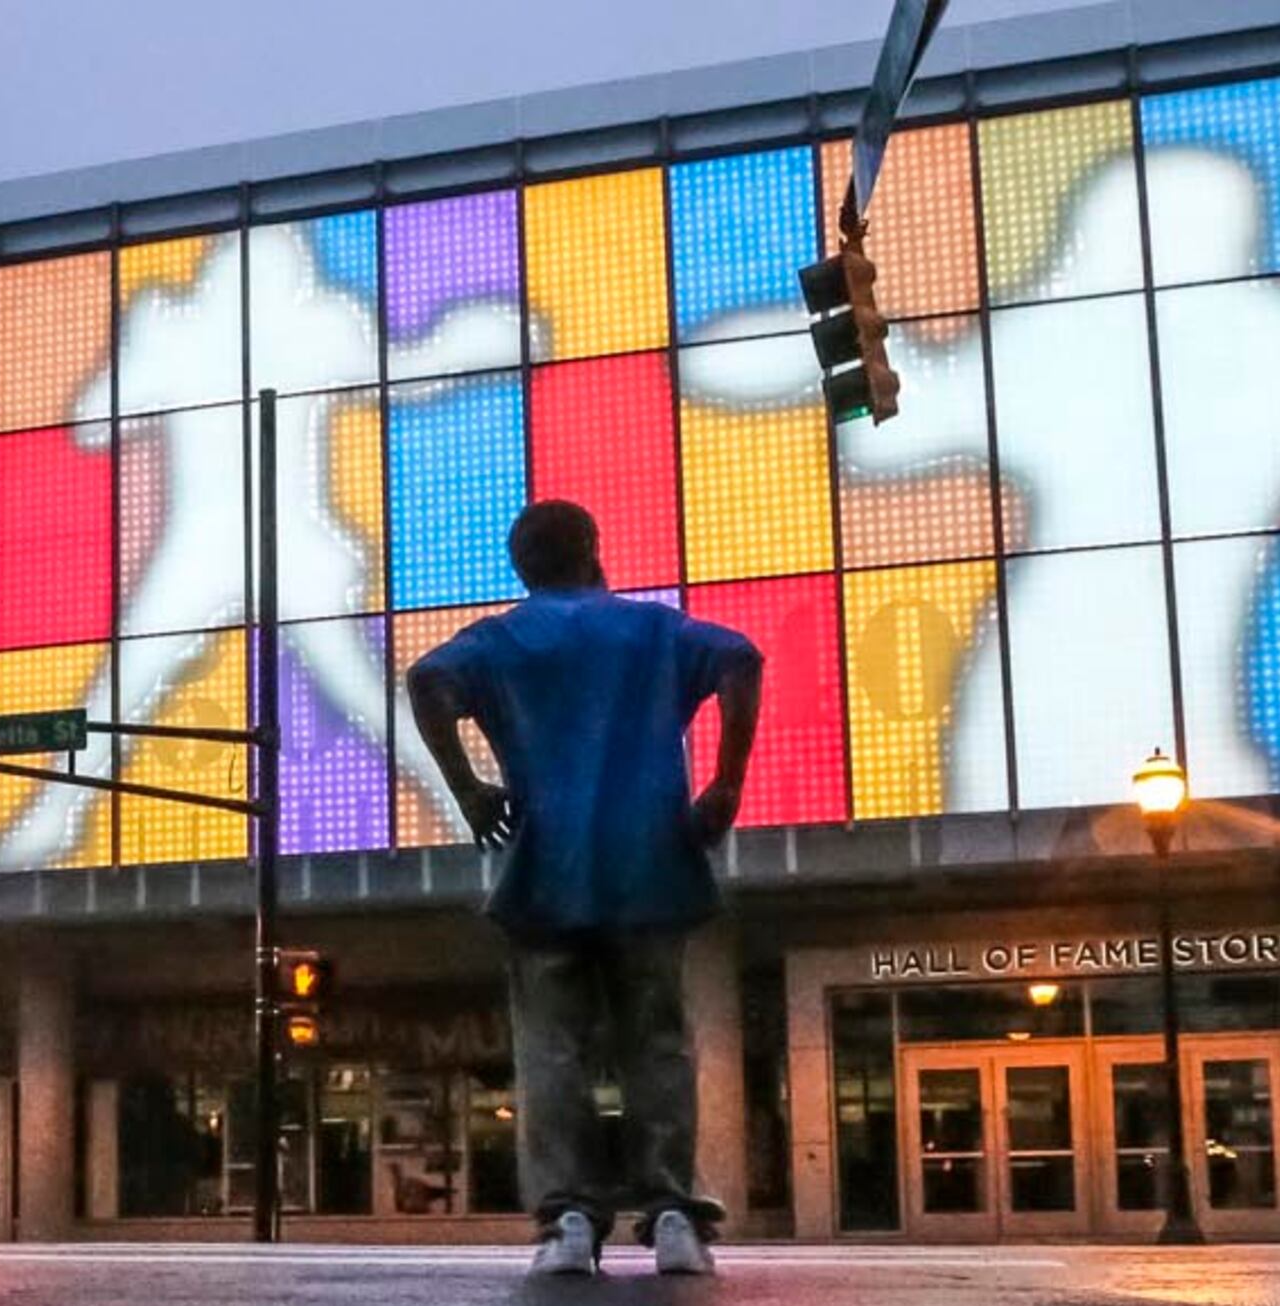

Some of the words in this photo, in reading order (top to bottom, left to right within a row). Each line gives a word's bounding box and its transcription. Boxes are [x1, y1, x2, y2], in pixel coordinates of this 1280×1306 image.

[53, 718, 79, 741] St
[870, 945, 970, 977] HALL
[982, 944, 1036, 972] OF
[1050, 938, 1160, 969] FAME
